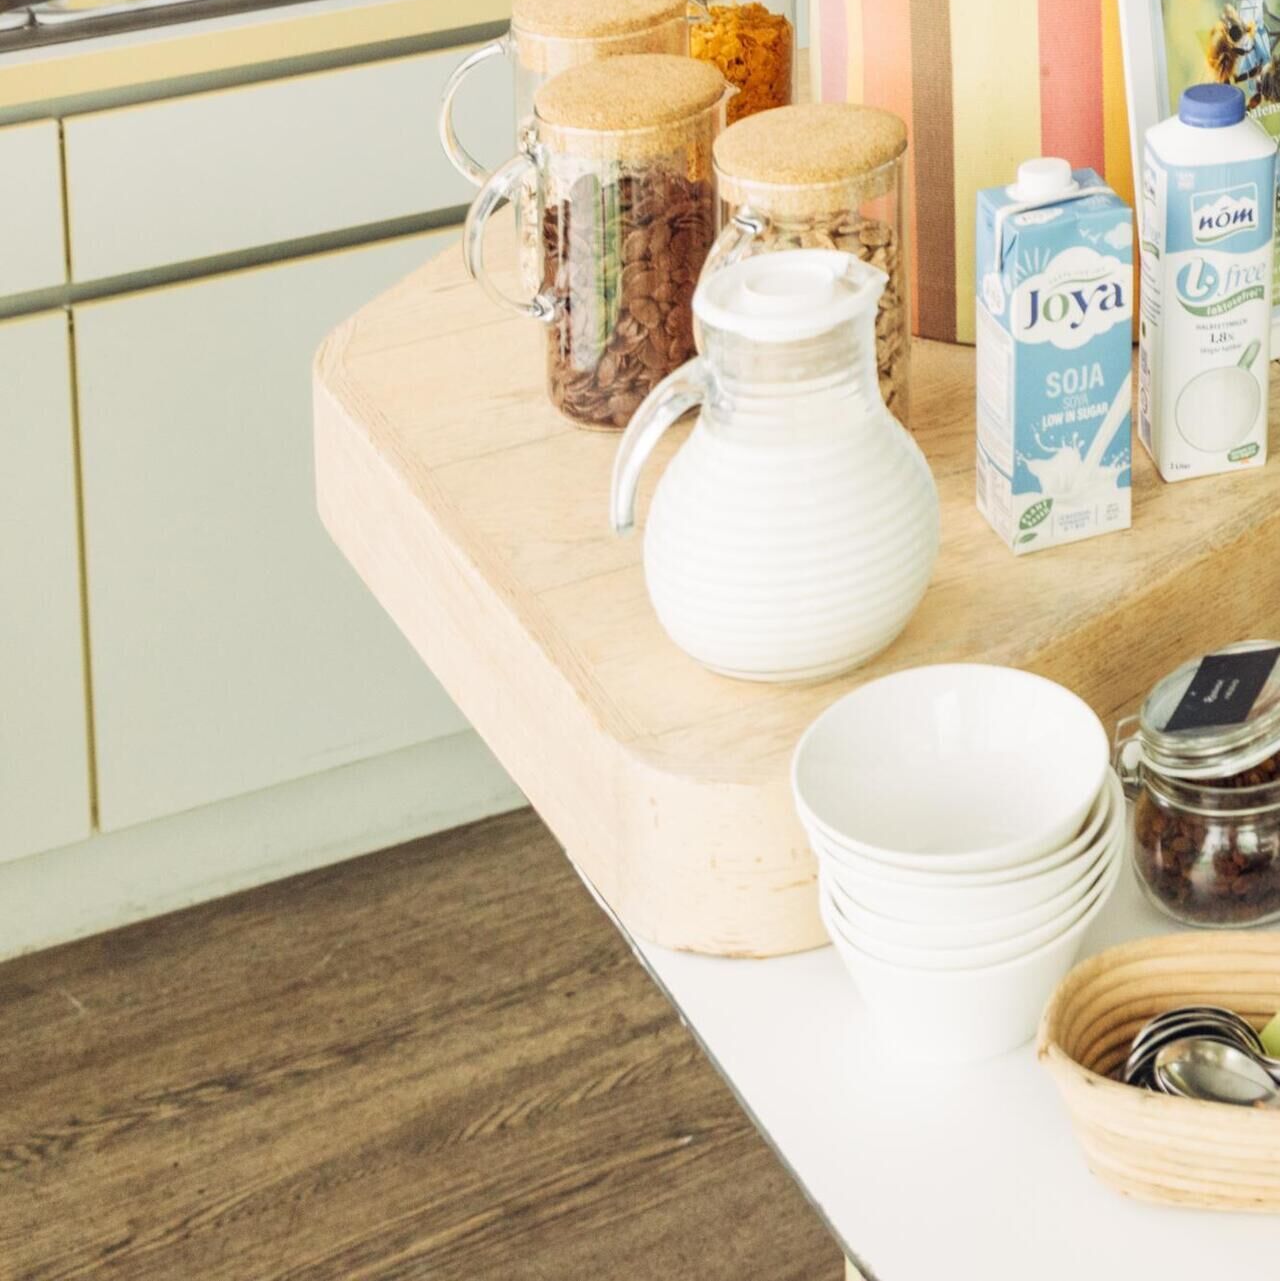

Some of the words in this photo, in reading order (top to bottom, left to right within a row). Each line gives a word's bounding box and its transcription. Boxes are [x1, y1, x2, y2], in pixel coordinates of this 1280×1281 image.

[1217, 262, 1266, 297] free
[1023, 282, 1125, 331] Joya
[1045, 361, 1105, 399] SOJA
[1042, 413, 1063, 432] LOW
[1065, 410, 1076, 423] IN
[1076, 401, 1109, 421] SUGAR
